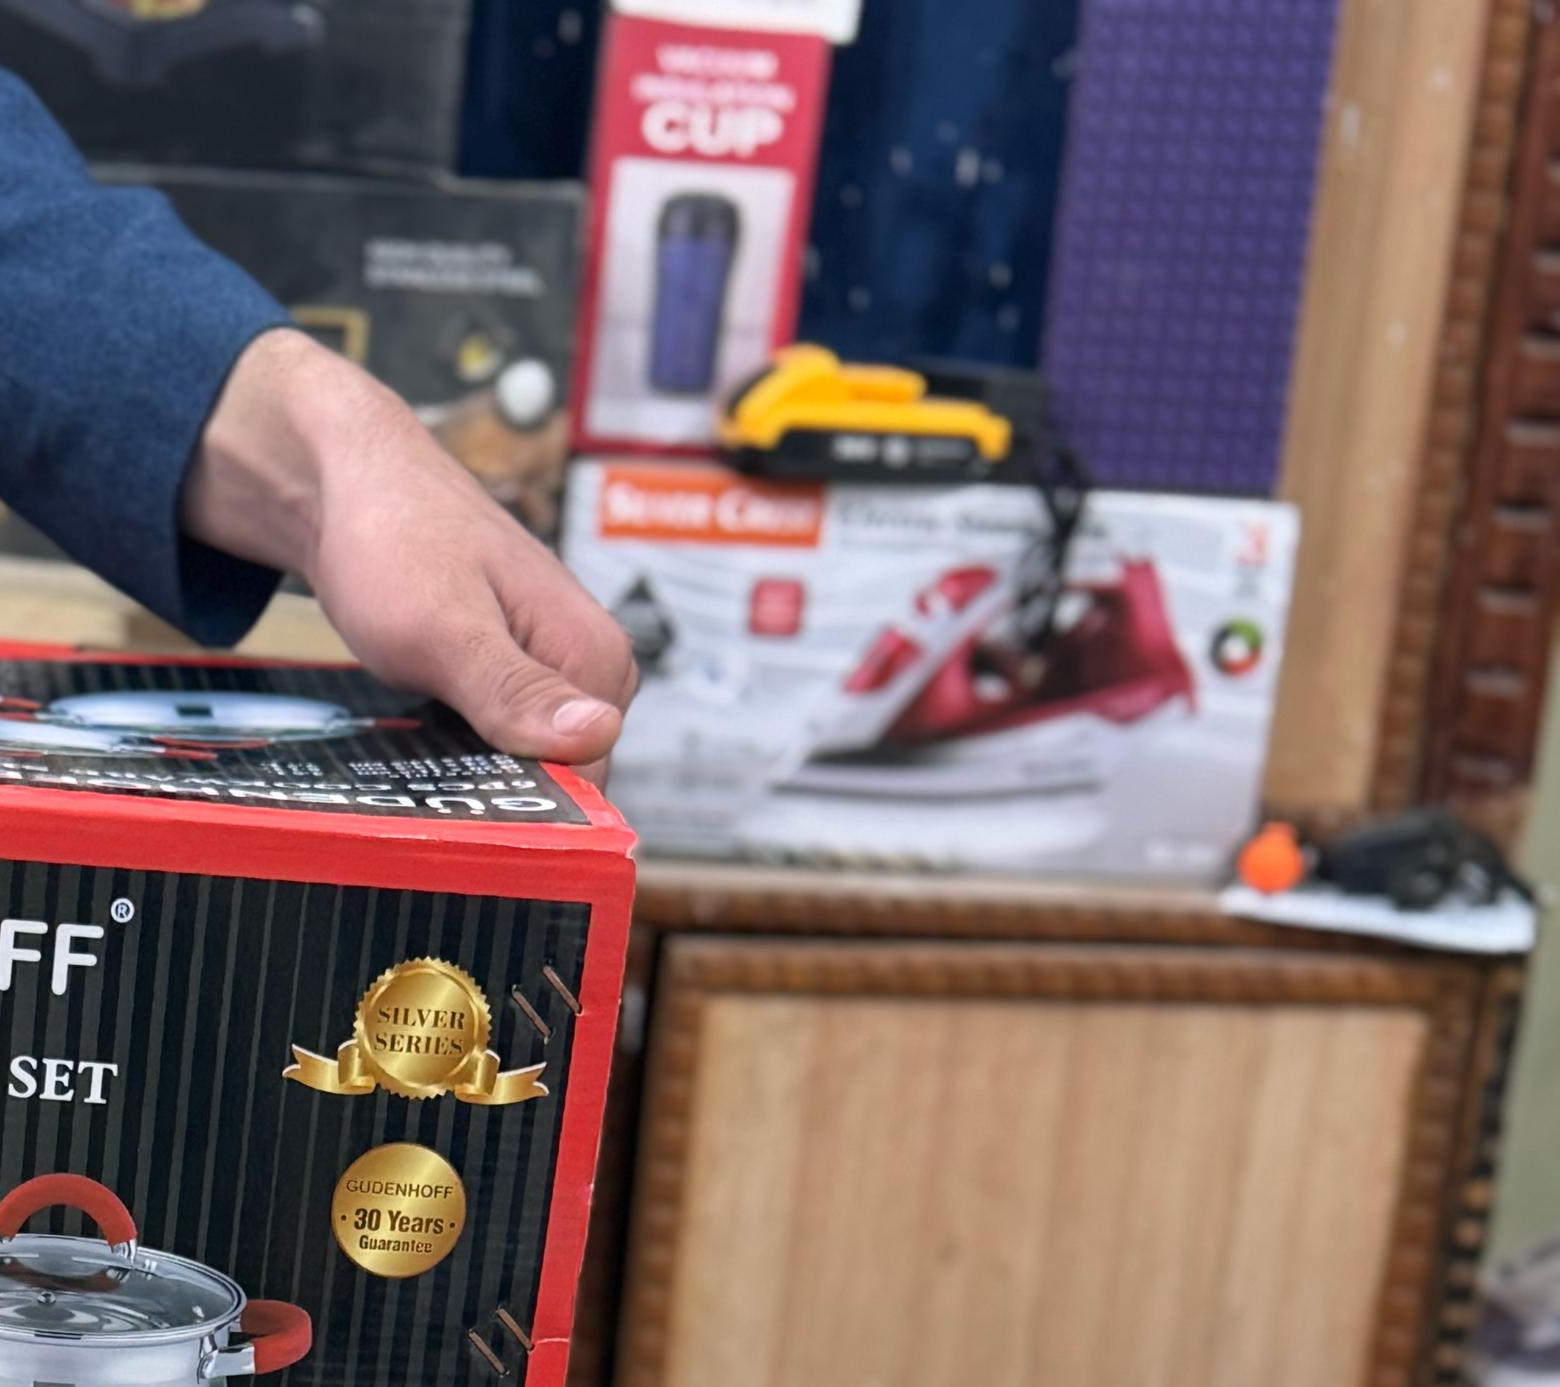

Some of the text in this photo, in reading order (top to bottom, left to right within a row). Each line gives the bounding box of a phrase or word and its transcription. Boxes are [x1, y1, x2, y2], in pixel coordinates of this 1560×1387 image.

[641, 101, 784, 158] CUP
[376, 1007, 466, 1031] SILVER
[373, 1032, 464, 1056] SERIES
[8, 1055, 119, 1105] SET
[354, 1208, 445, 1235] 30 Years
[359, 1235, 433, 1254] Guarantee
